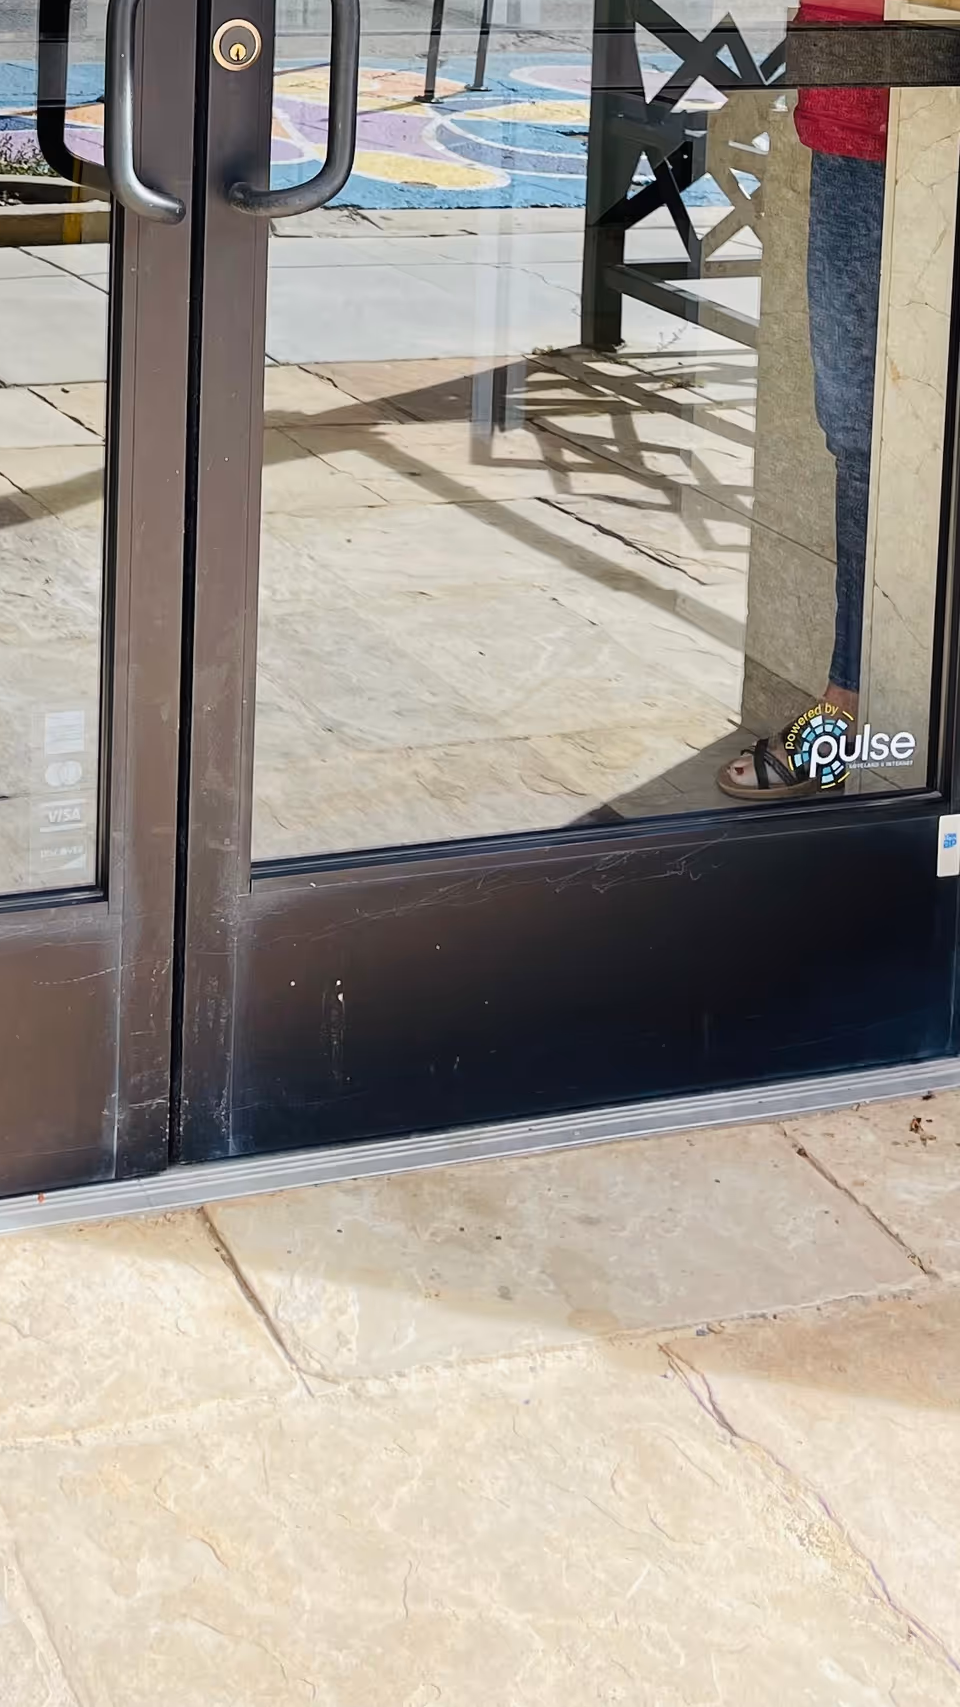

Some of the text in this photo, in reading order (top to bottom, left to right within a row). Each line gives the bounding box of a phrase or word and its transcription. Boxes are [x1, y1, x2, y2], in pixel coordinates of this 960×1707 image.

[785, 702, 839, 750] powered by
[809, 723, 916, 778] pulse
[48, 807, 81, 823] VISA
